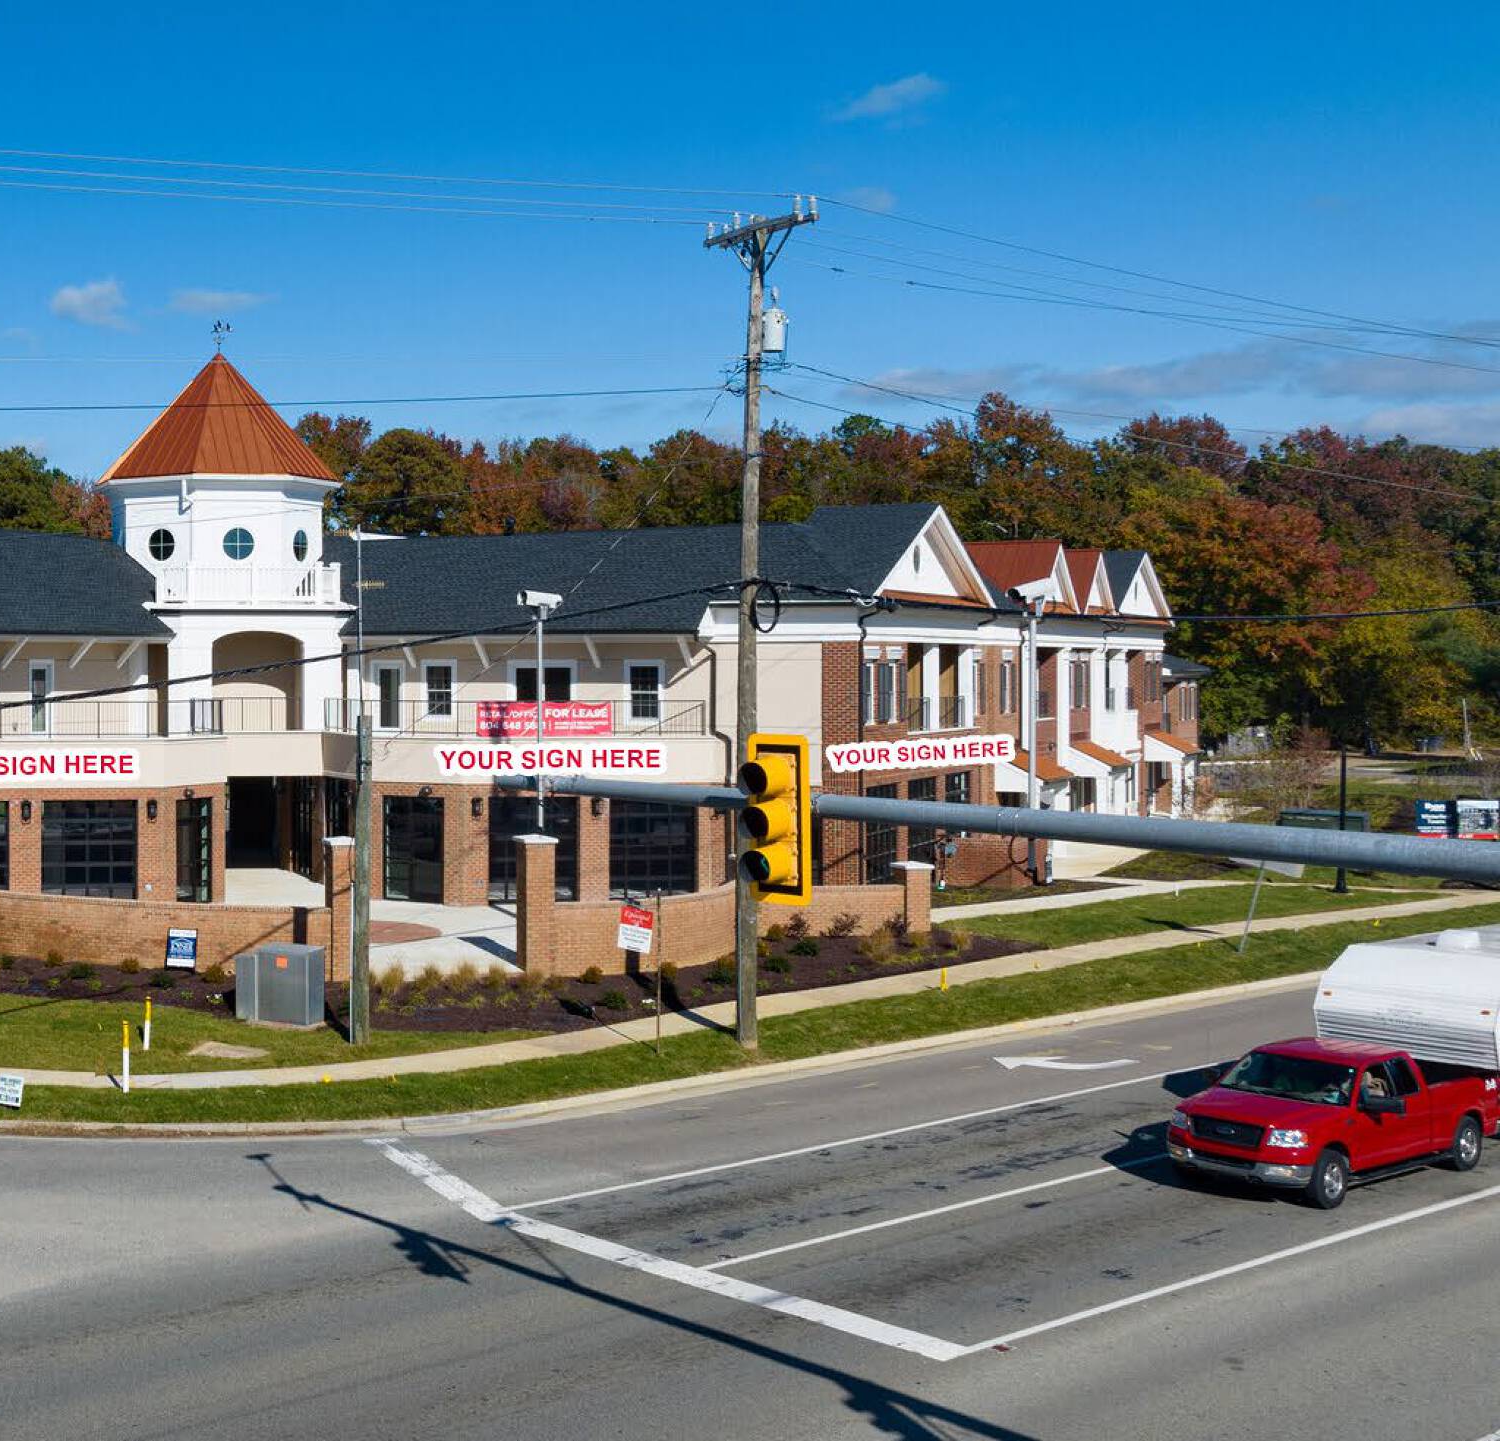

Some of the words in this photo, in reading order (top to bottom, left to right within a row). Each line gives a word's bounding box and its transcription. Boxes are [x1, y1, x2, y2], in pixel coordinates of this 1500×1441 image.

[479, 709, 539, 720] RETAL/OFFIC
[545, 708, 569, 718] FOR
[572, 708, 608, 718] LEASE
